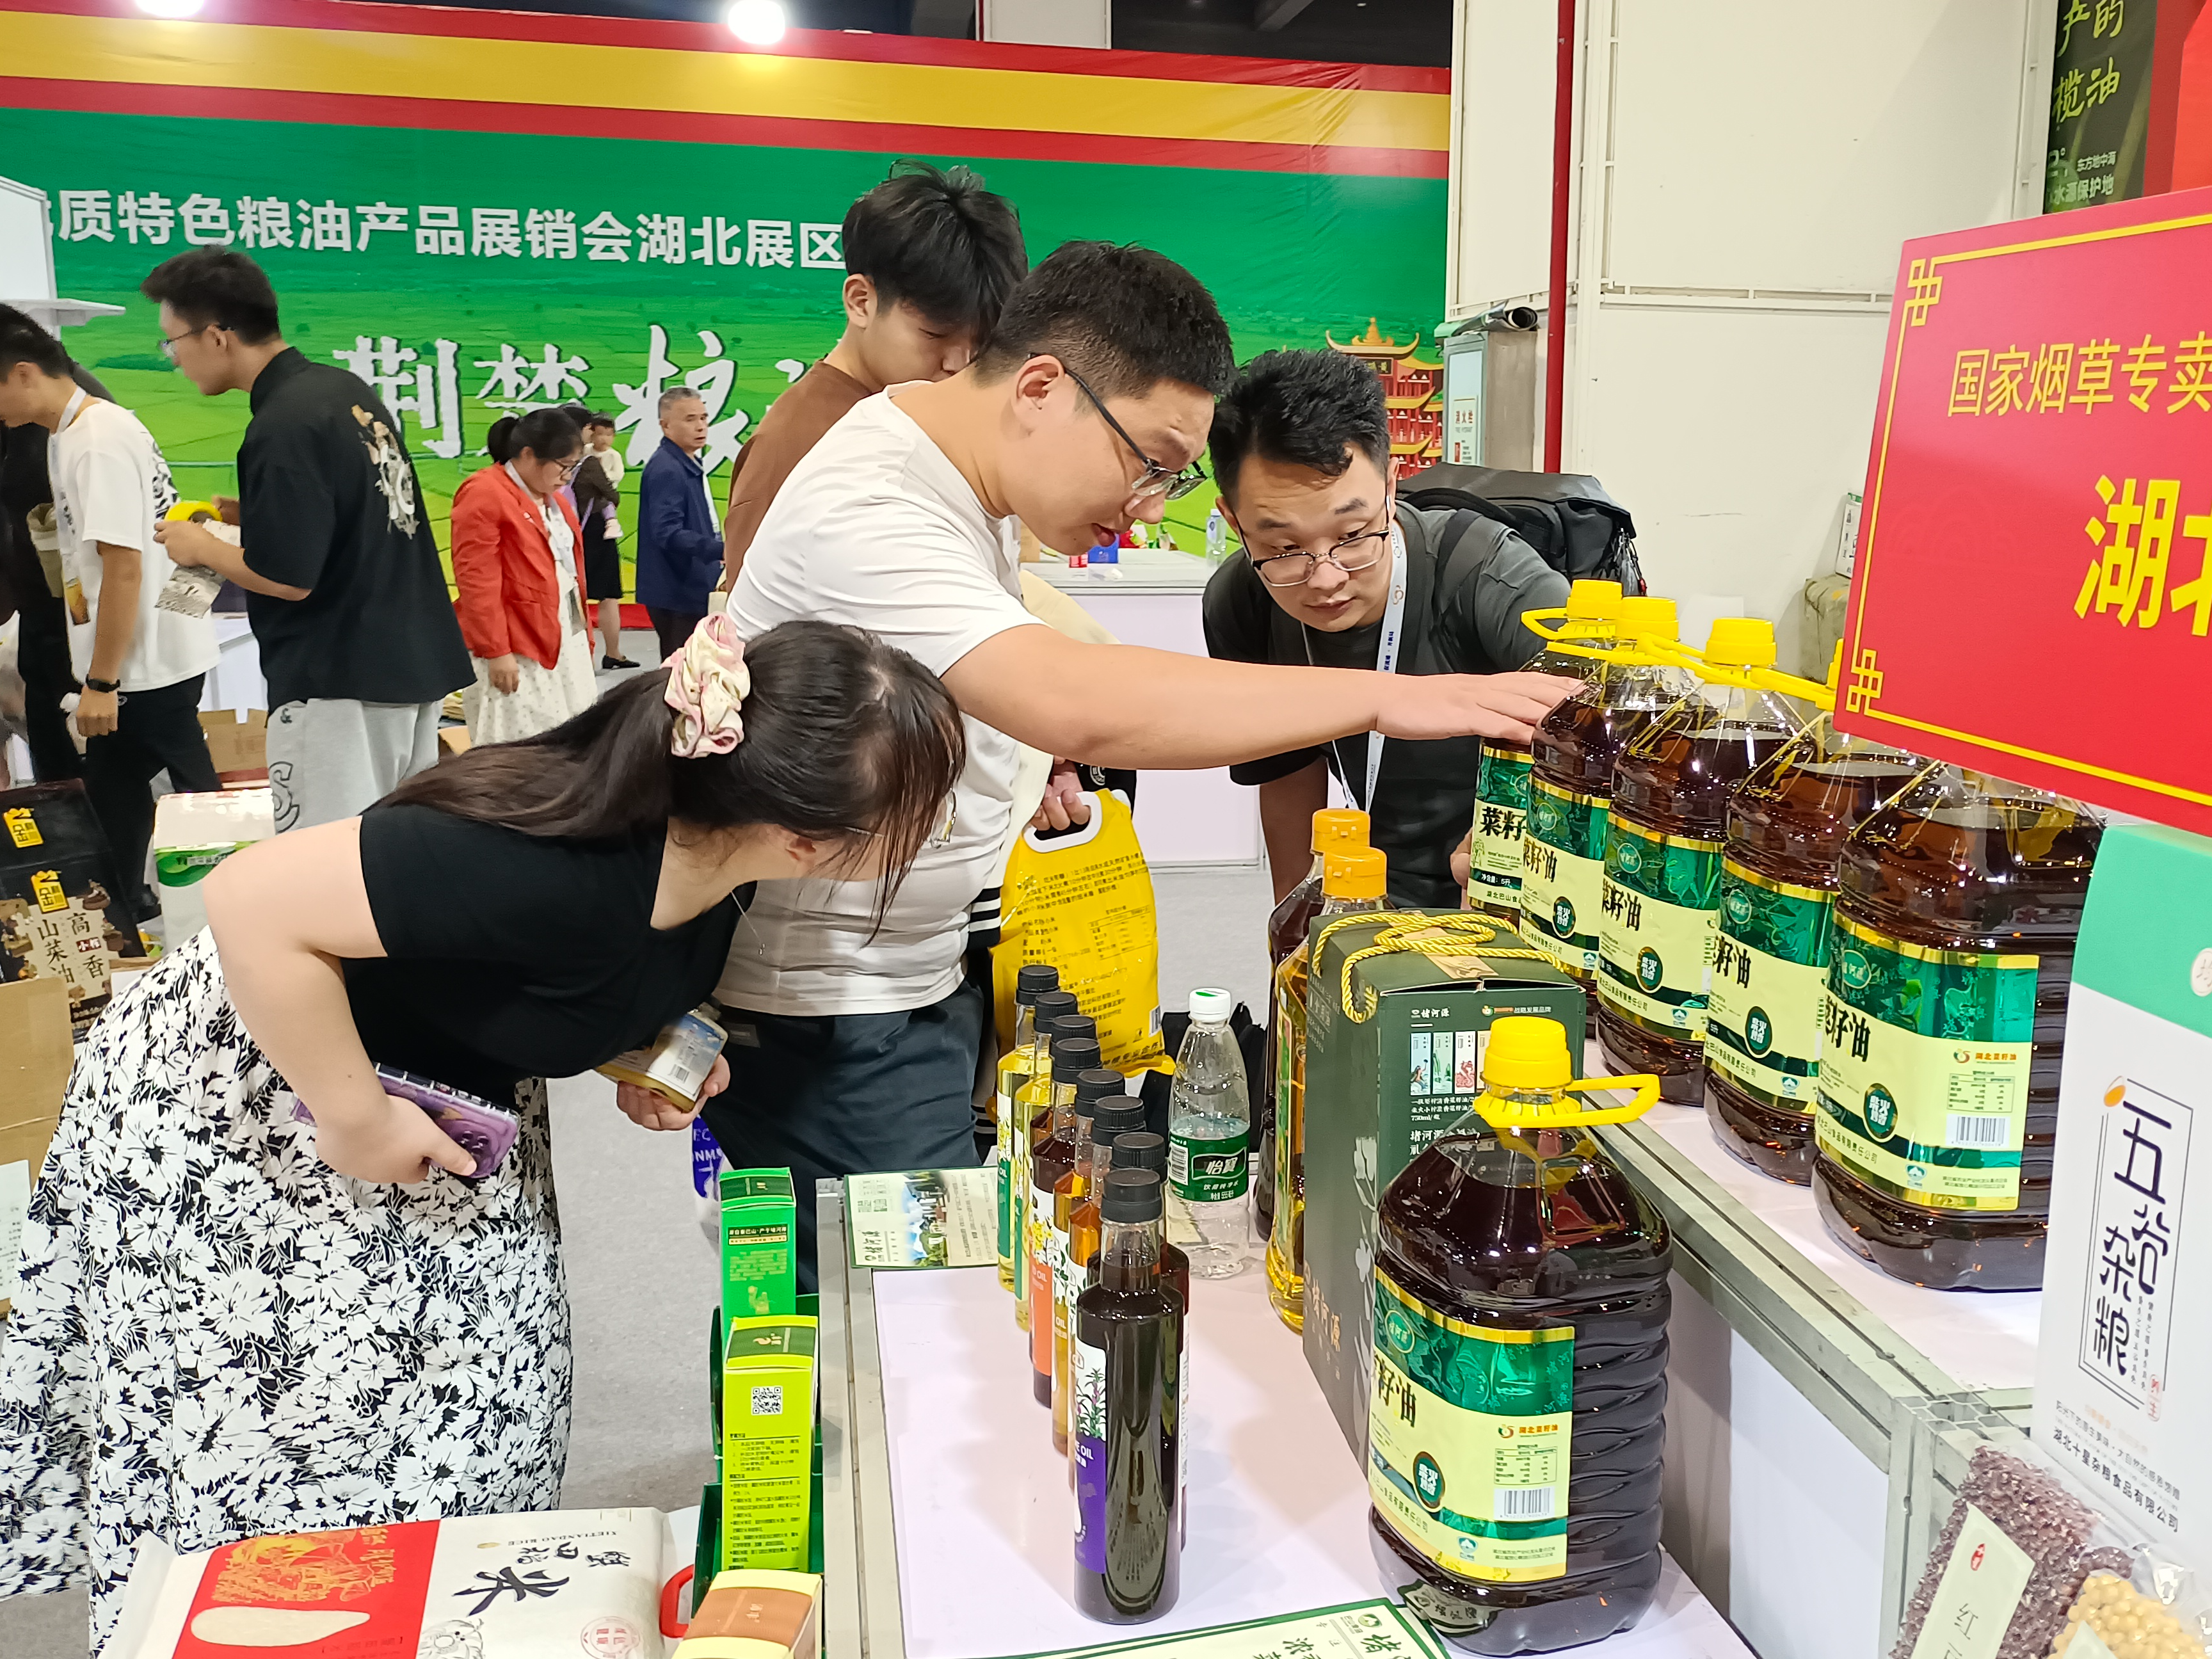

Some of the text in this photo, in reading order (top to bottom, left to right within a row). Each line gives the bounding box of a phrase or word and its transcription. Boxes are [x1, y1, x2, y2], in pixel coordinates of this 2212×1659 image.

[47, 189, 846, 269] 质特色粮油产品展销会湖北展区
[1947, 331, 2212, 417] 国家烟草专卖
[333, 323, 808, 476] 荆楚粮
[1486, 890, 1522, 903] 湖北巴山食
[2094, 1100, 2172, 1376] 五谷杂粮
[1036, 1270, 1048, 1283] OIL
[1055, 1316, 1067, 1330] OIL
[1080, 1447, 1094, 1461] OIL
